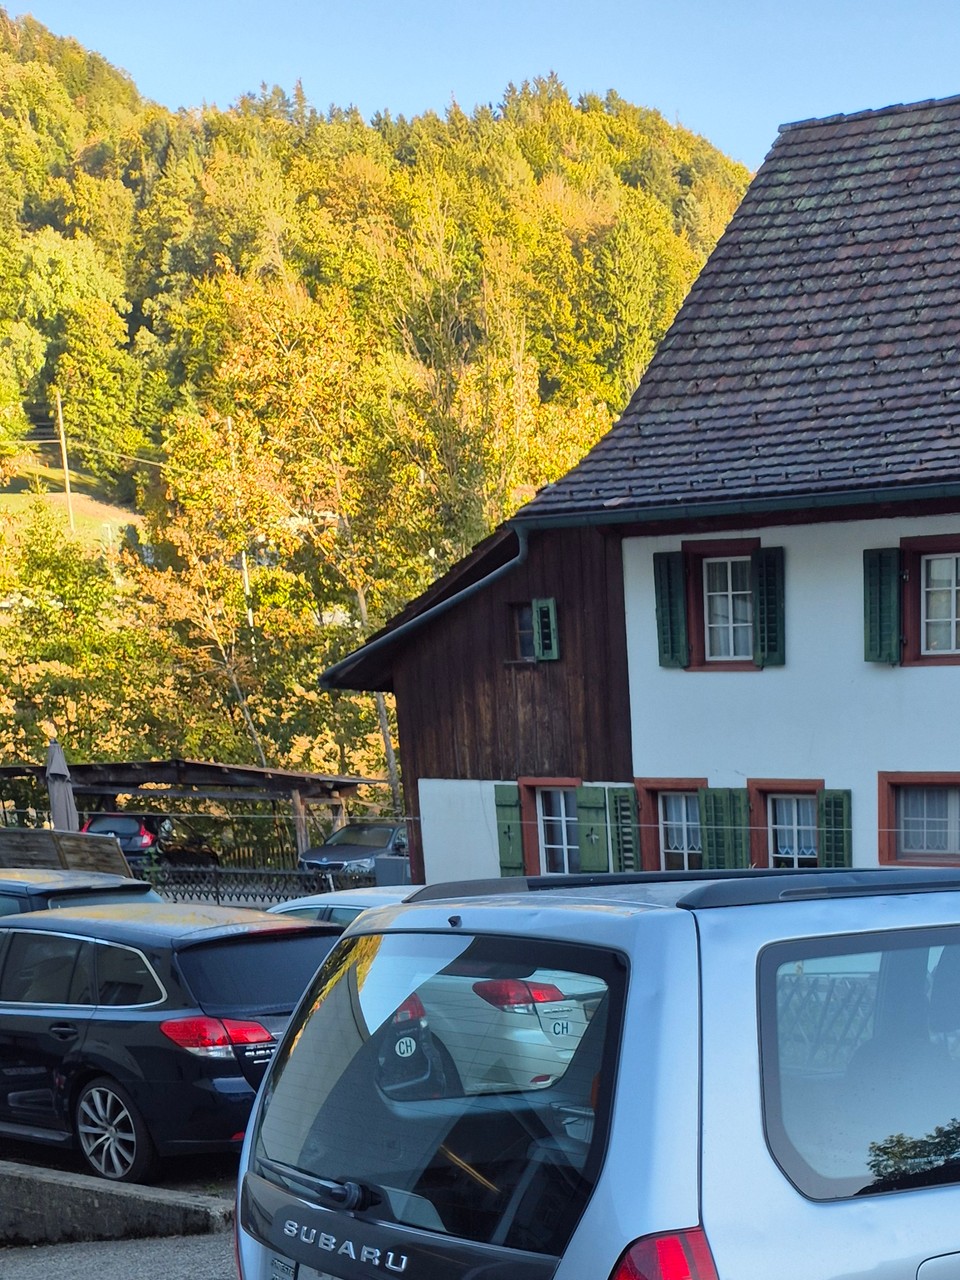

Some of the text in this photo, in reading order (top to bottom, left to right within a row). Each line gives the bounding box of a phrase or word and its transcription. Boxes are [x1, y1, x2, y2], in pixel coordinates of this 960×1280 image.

[552, 1021, 569, 1036] CH
[398, 1039, 413, 1055] CH
[283, 1219, 408, 1273] SUBARU
